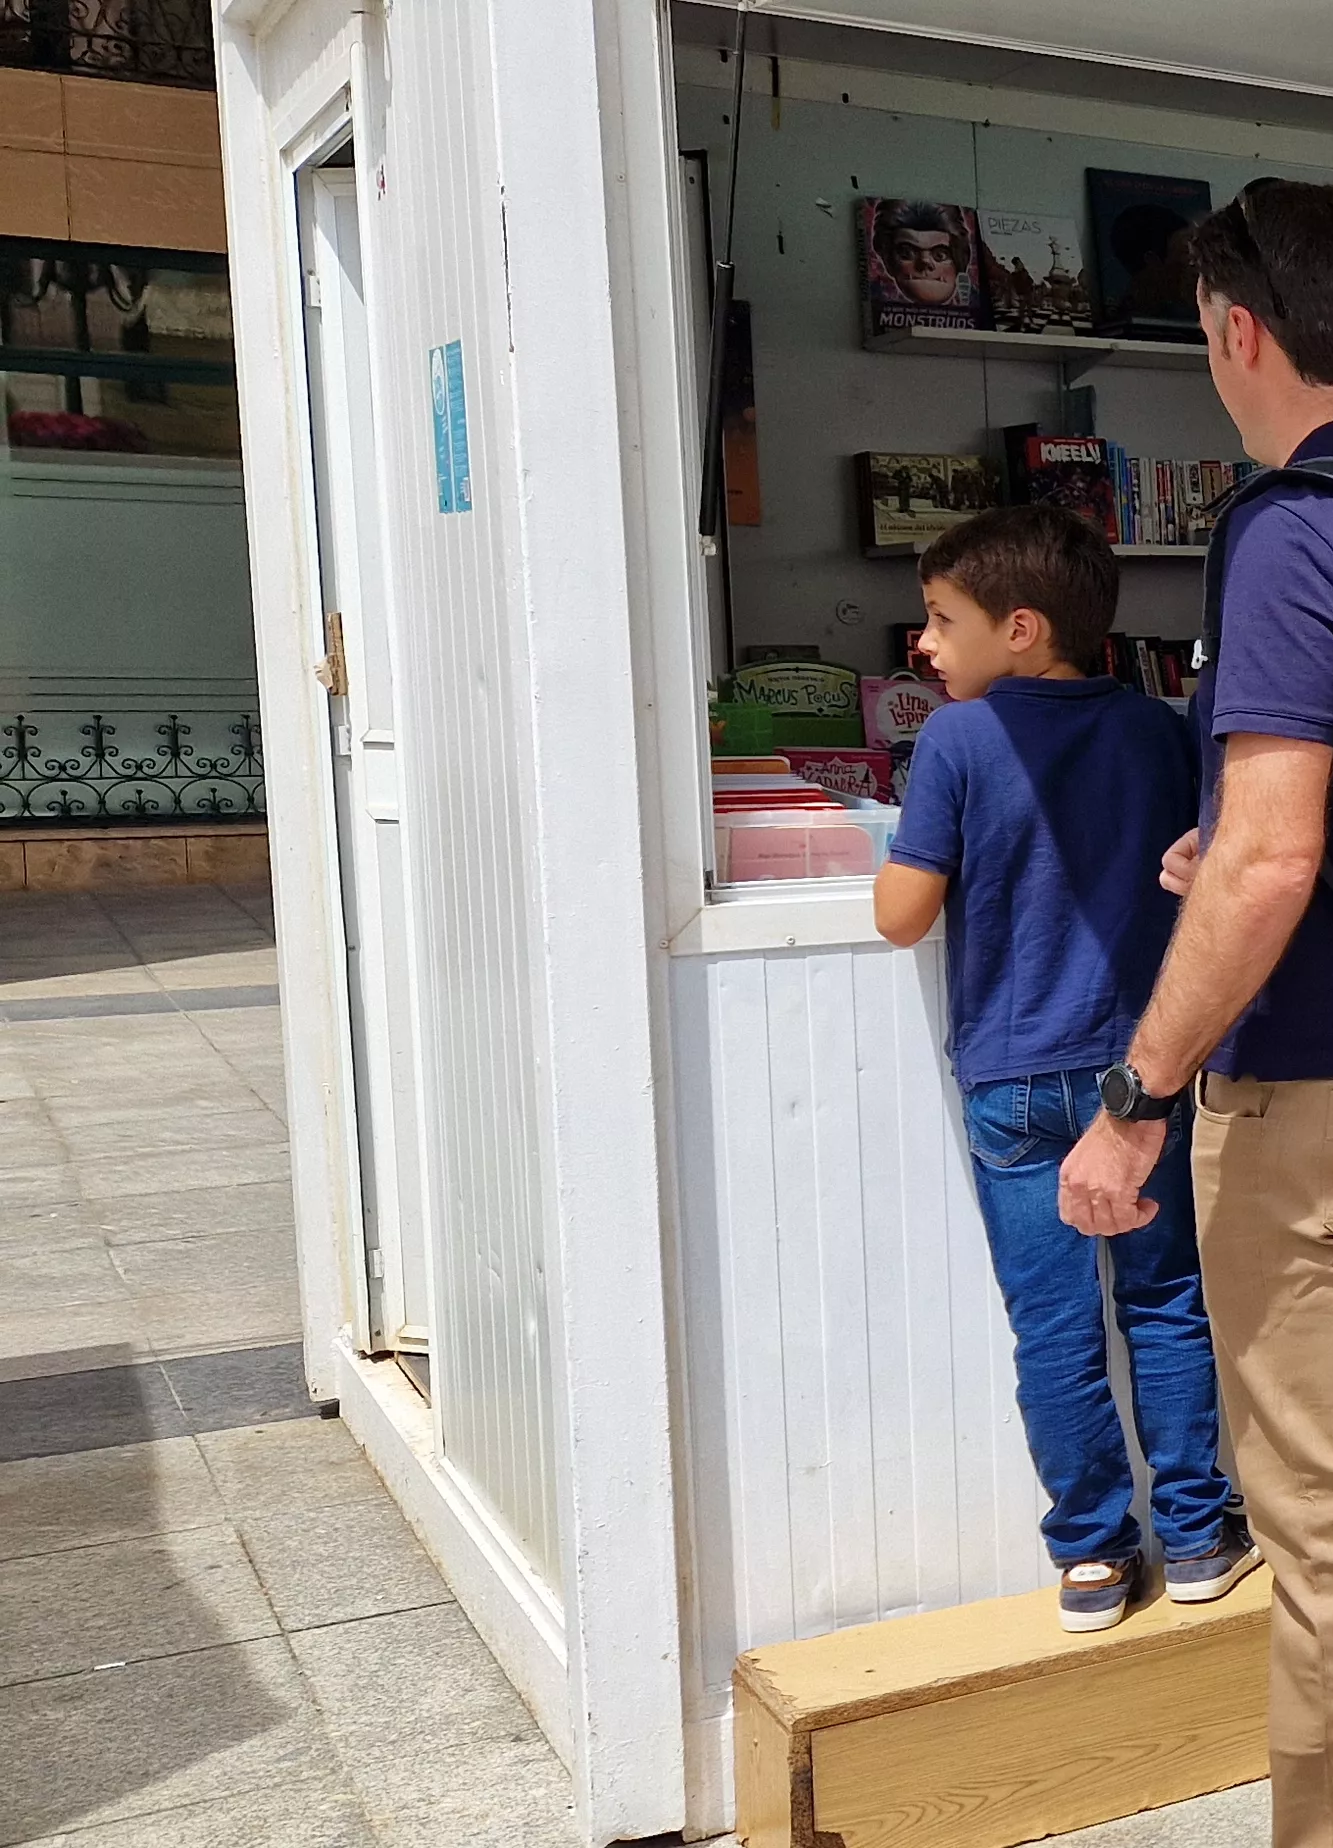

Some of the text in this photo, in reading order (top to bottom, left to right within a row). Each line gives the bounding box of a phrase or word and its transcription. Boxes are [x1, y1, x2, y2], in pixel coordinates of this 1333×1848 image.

[988, 216, 1041, 233] PIEZAS
[880, 311, 976, 330] MONSTRUOS
[735, 679, 799, 706] MARCUS
[896, 692, 929, 711] Lina
[821, 761, 857, 776] Anna
